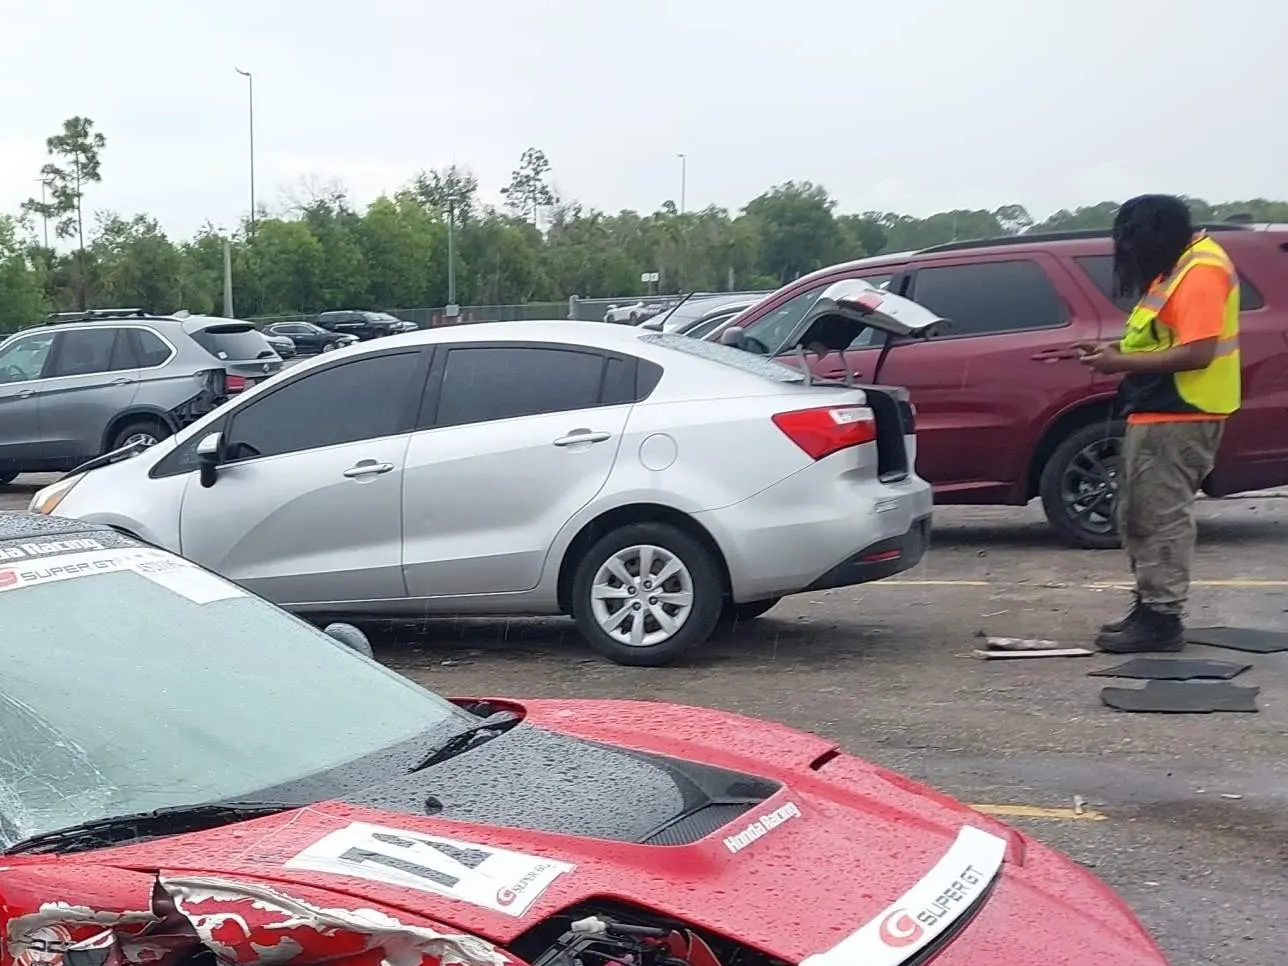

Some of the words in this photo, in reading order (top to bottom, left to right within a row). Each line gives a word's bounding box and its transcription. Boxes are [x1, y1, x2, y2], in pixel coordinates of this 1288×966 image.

[20, 536, 103, 559] Racing
[20, 562, 91, 582] SUPER
[93, 558, 116, 571] GT
[916, 876, 969, 926] SUPER
[960, 864, 985, 886] GT
